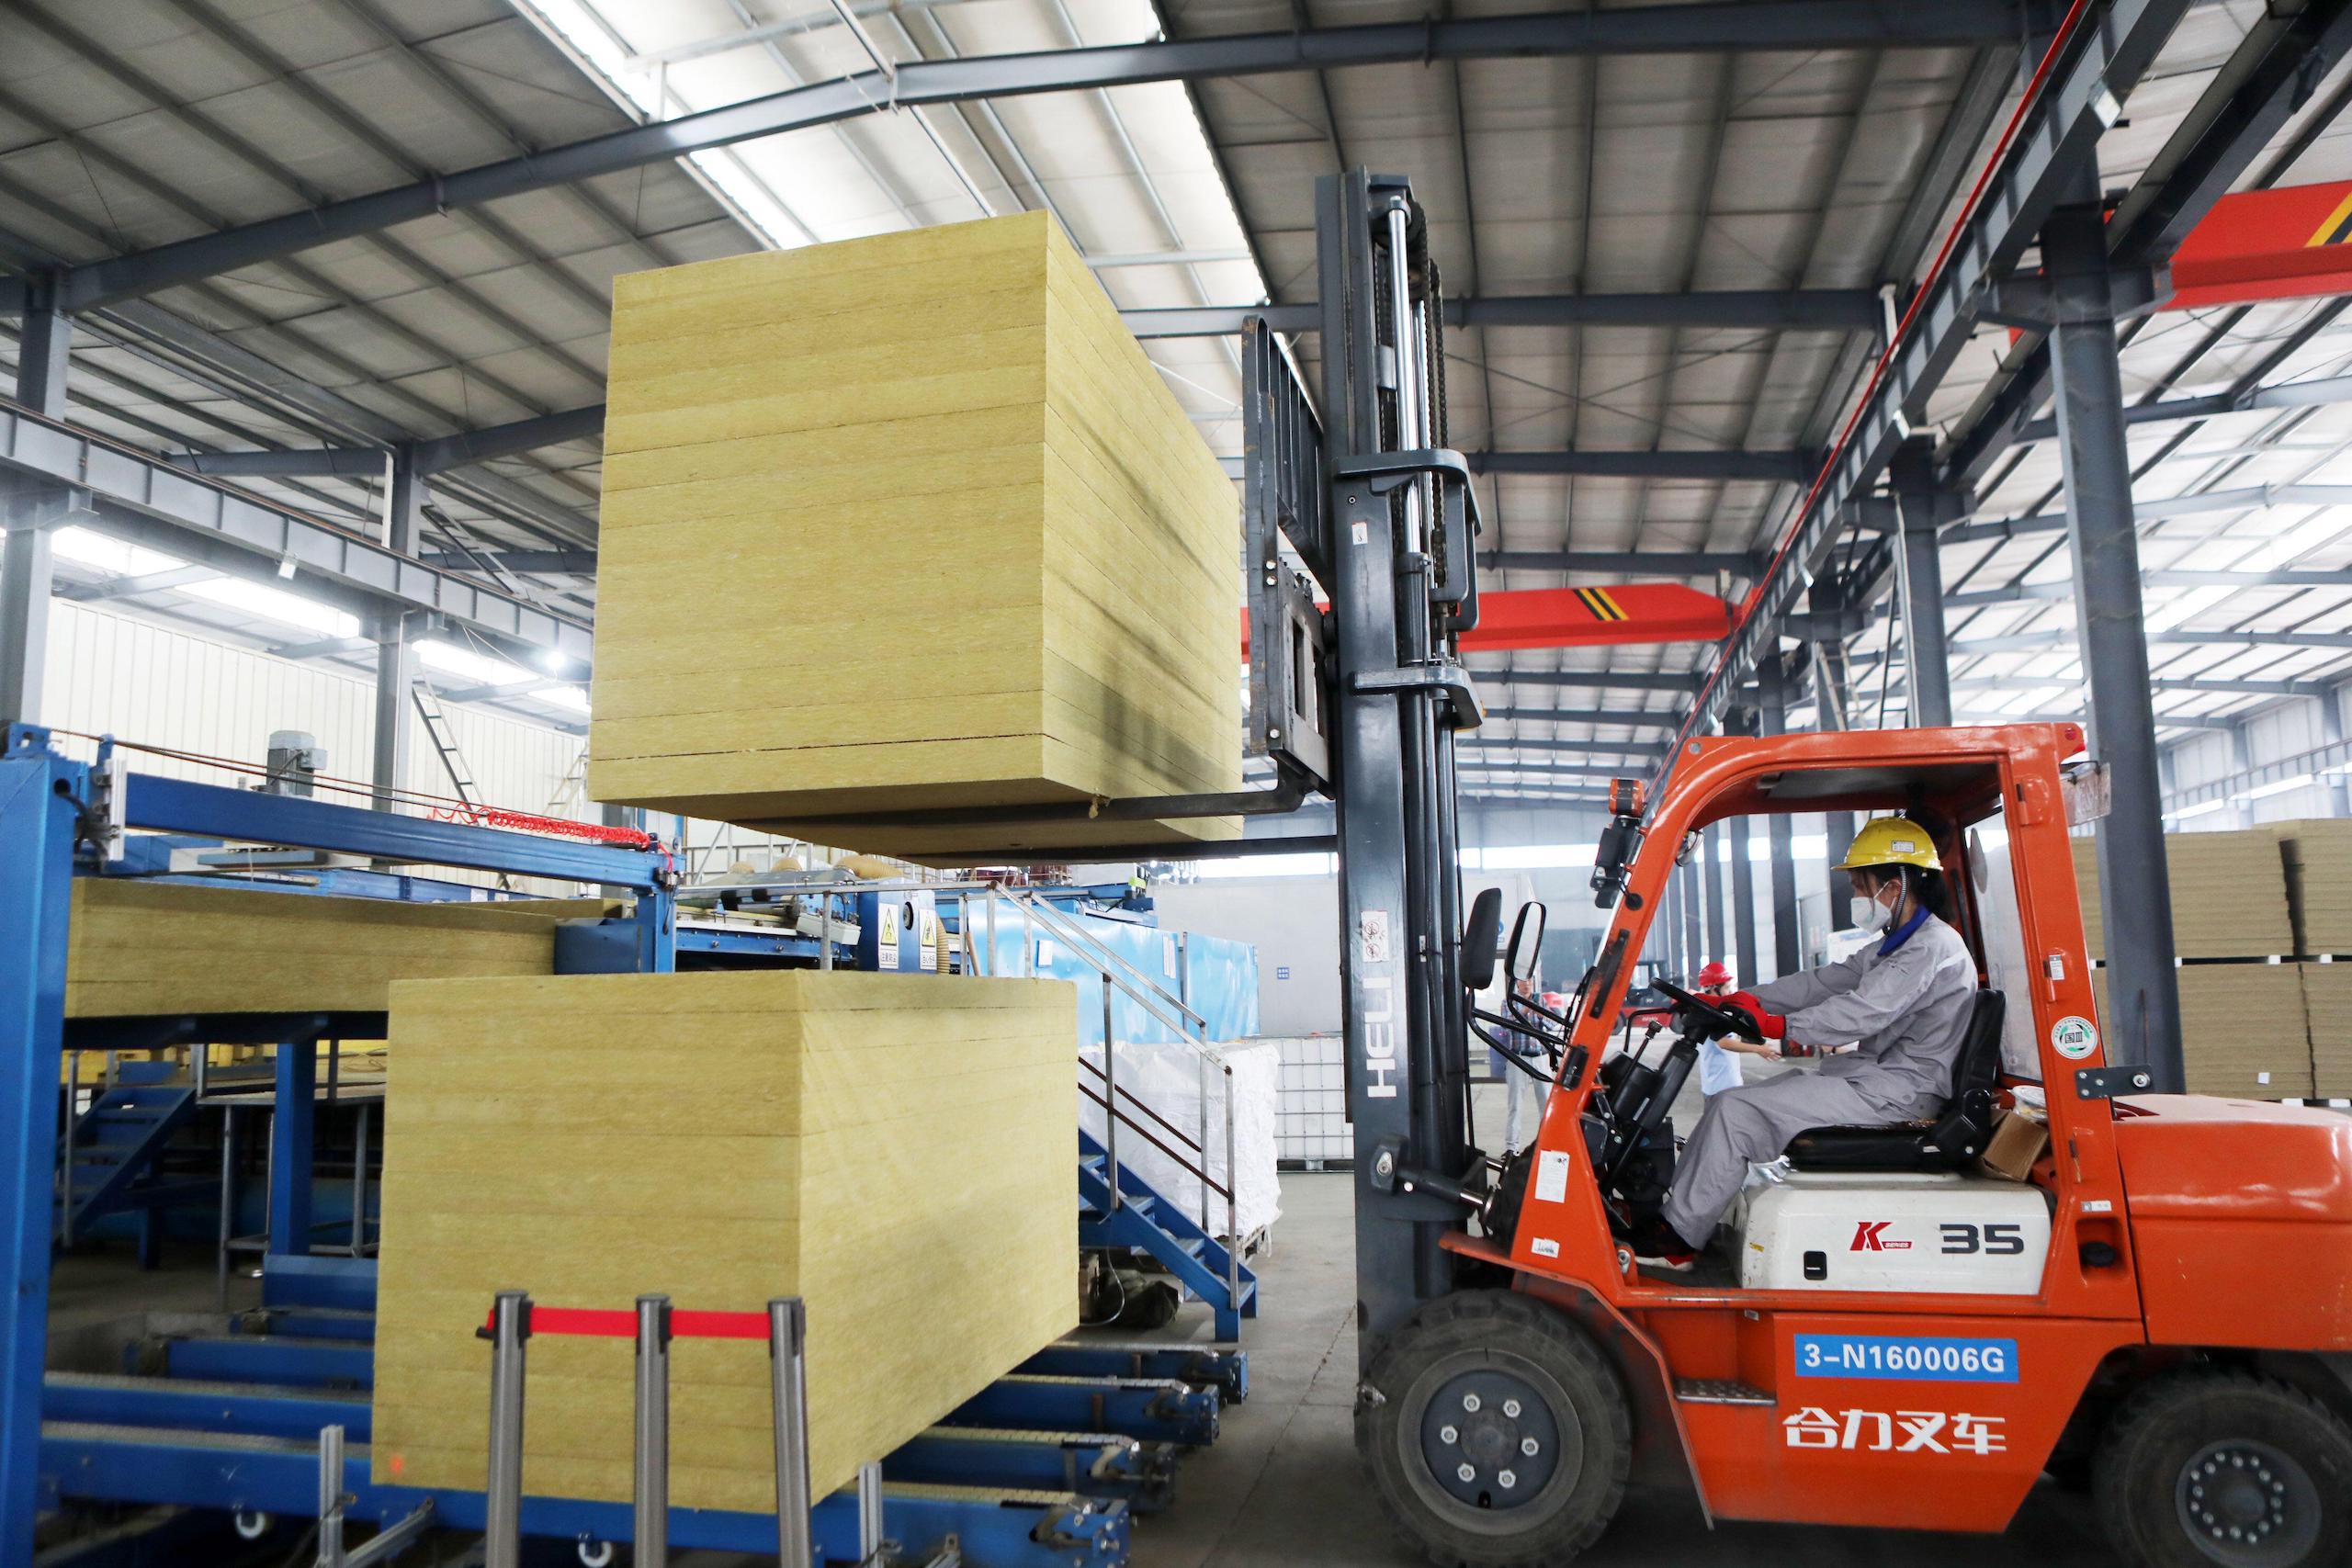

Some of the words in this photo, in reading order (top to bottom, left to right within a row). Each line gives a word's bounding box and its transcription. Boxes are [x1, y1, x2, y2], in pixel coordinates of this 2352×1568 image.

[1363, 976, 1397, 1098] HELI
[1849, 1222, 1893, 1251] K
[1939, 1224, 2025, 1255] 35
[1804, 1343, 2005, 1372] 3-N160006G
[1782, 1406, 2007, 1455] 合力叉车
